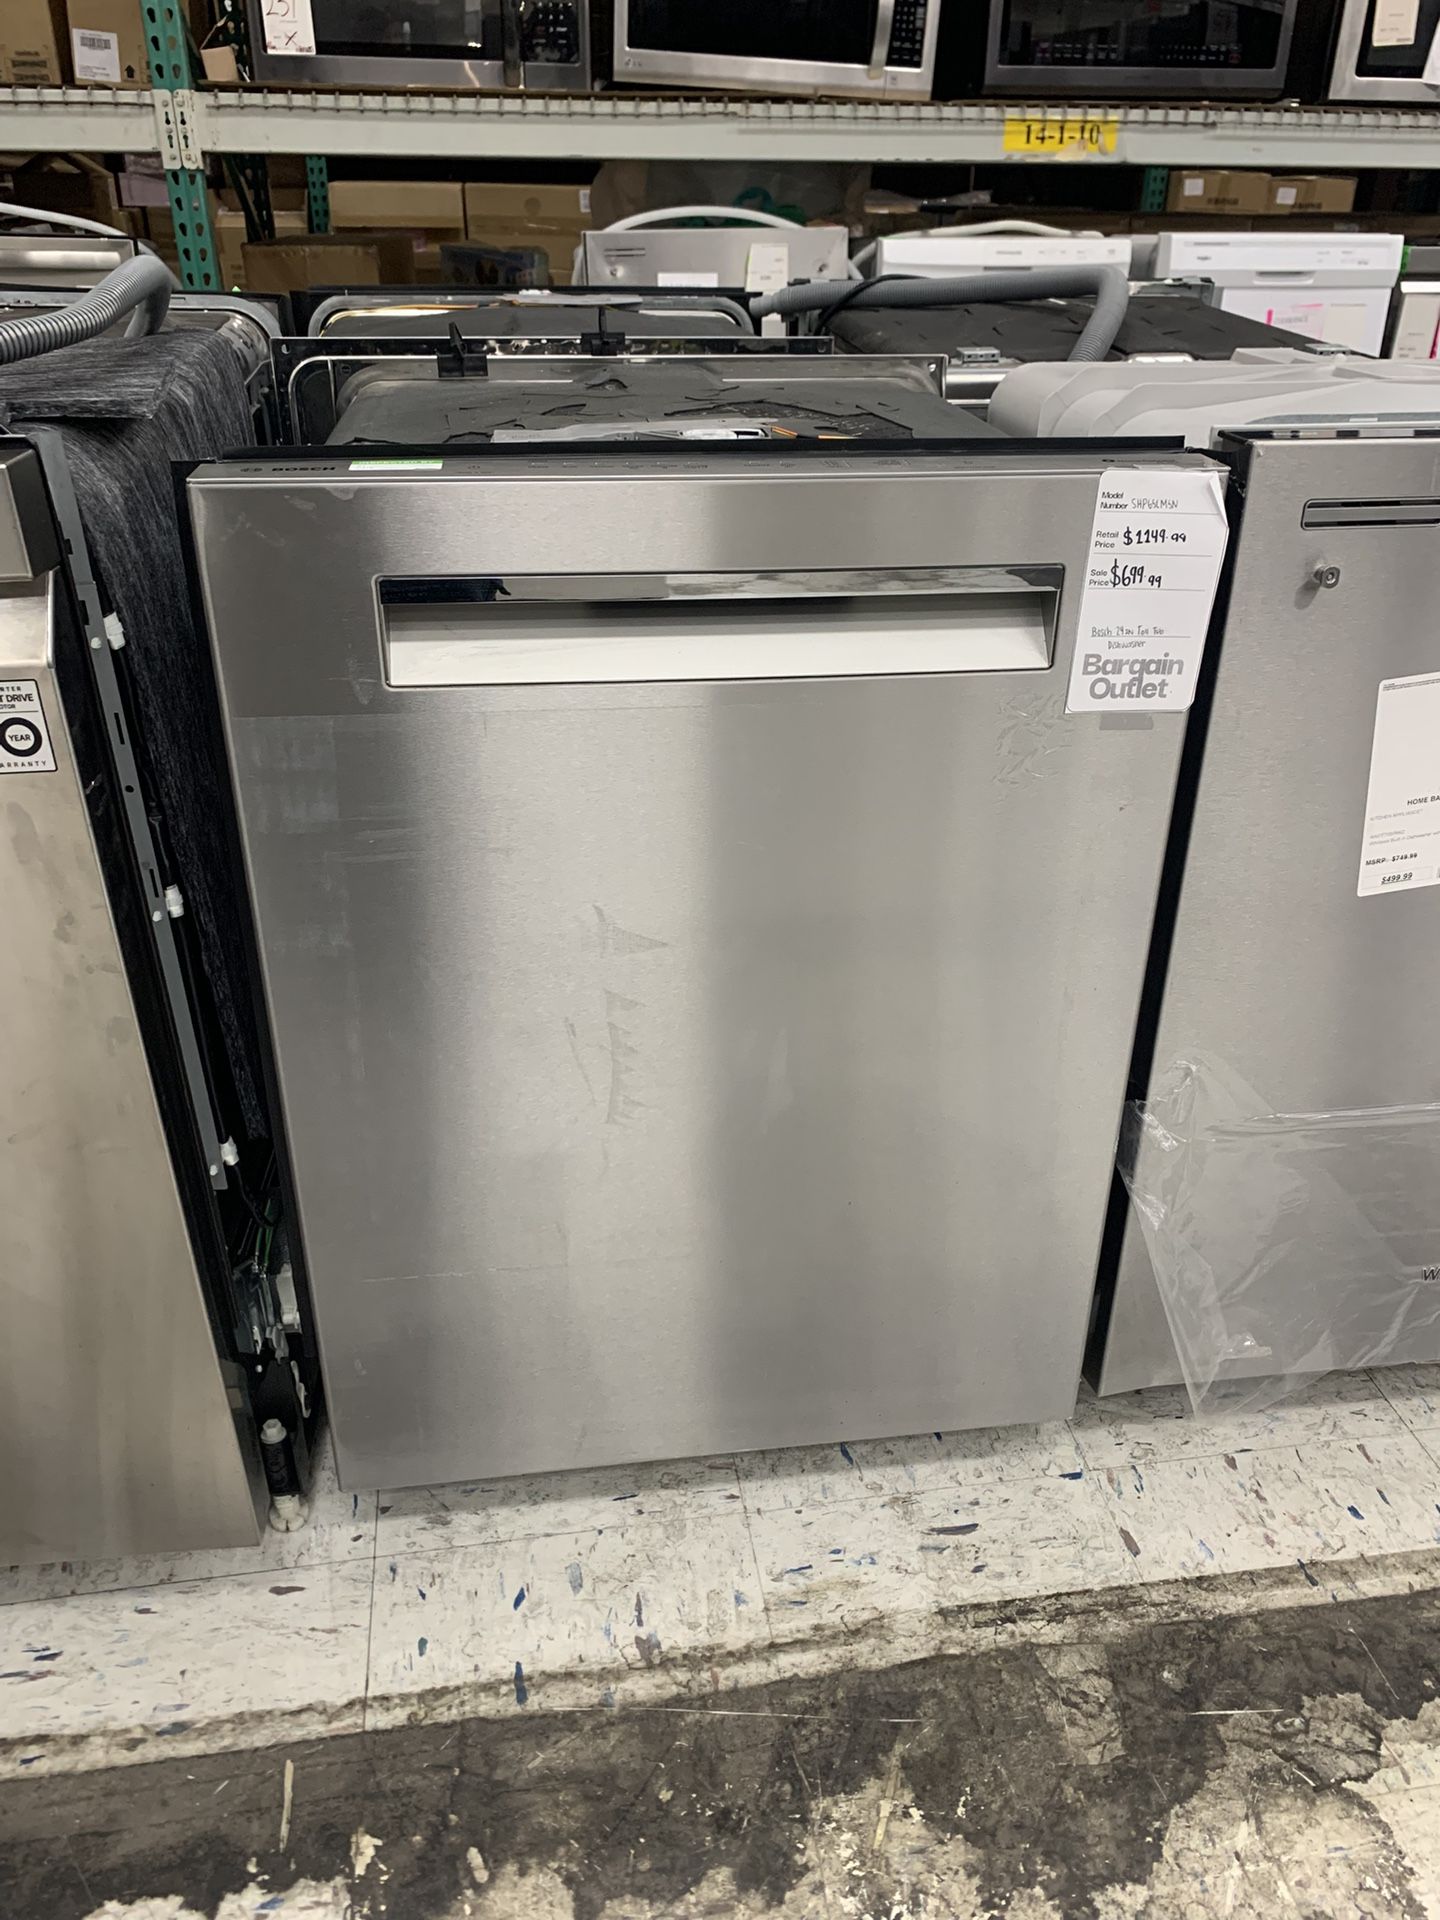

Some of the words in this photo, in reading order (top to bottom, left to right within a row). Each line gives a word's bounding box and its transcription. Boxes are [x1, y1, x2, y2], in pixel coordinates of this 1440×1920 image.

[1025, 123, 1101, 145] 14-1-10
[1101, 491, 1124, 499] Model
[1100, 501, 1128, 510] Number
[1096, 530, 1119, 539] Retail
[1095, 540, 1116, 548] Price
[1090, 569, 1108, 577] Sale
[1082, 652, 1184, 677] Bargain
[1089, 677, 1169, 699] Outlet
[6, 693, 34, 702] DRIVE
[1407, 797, 1428, 805] HOME
